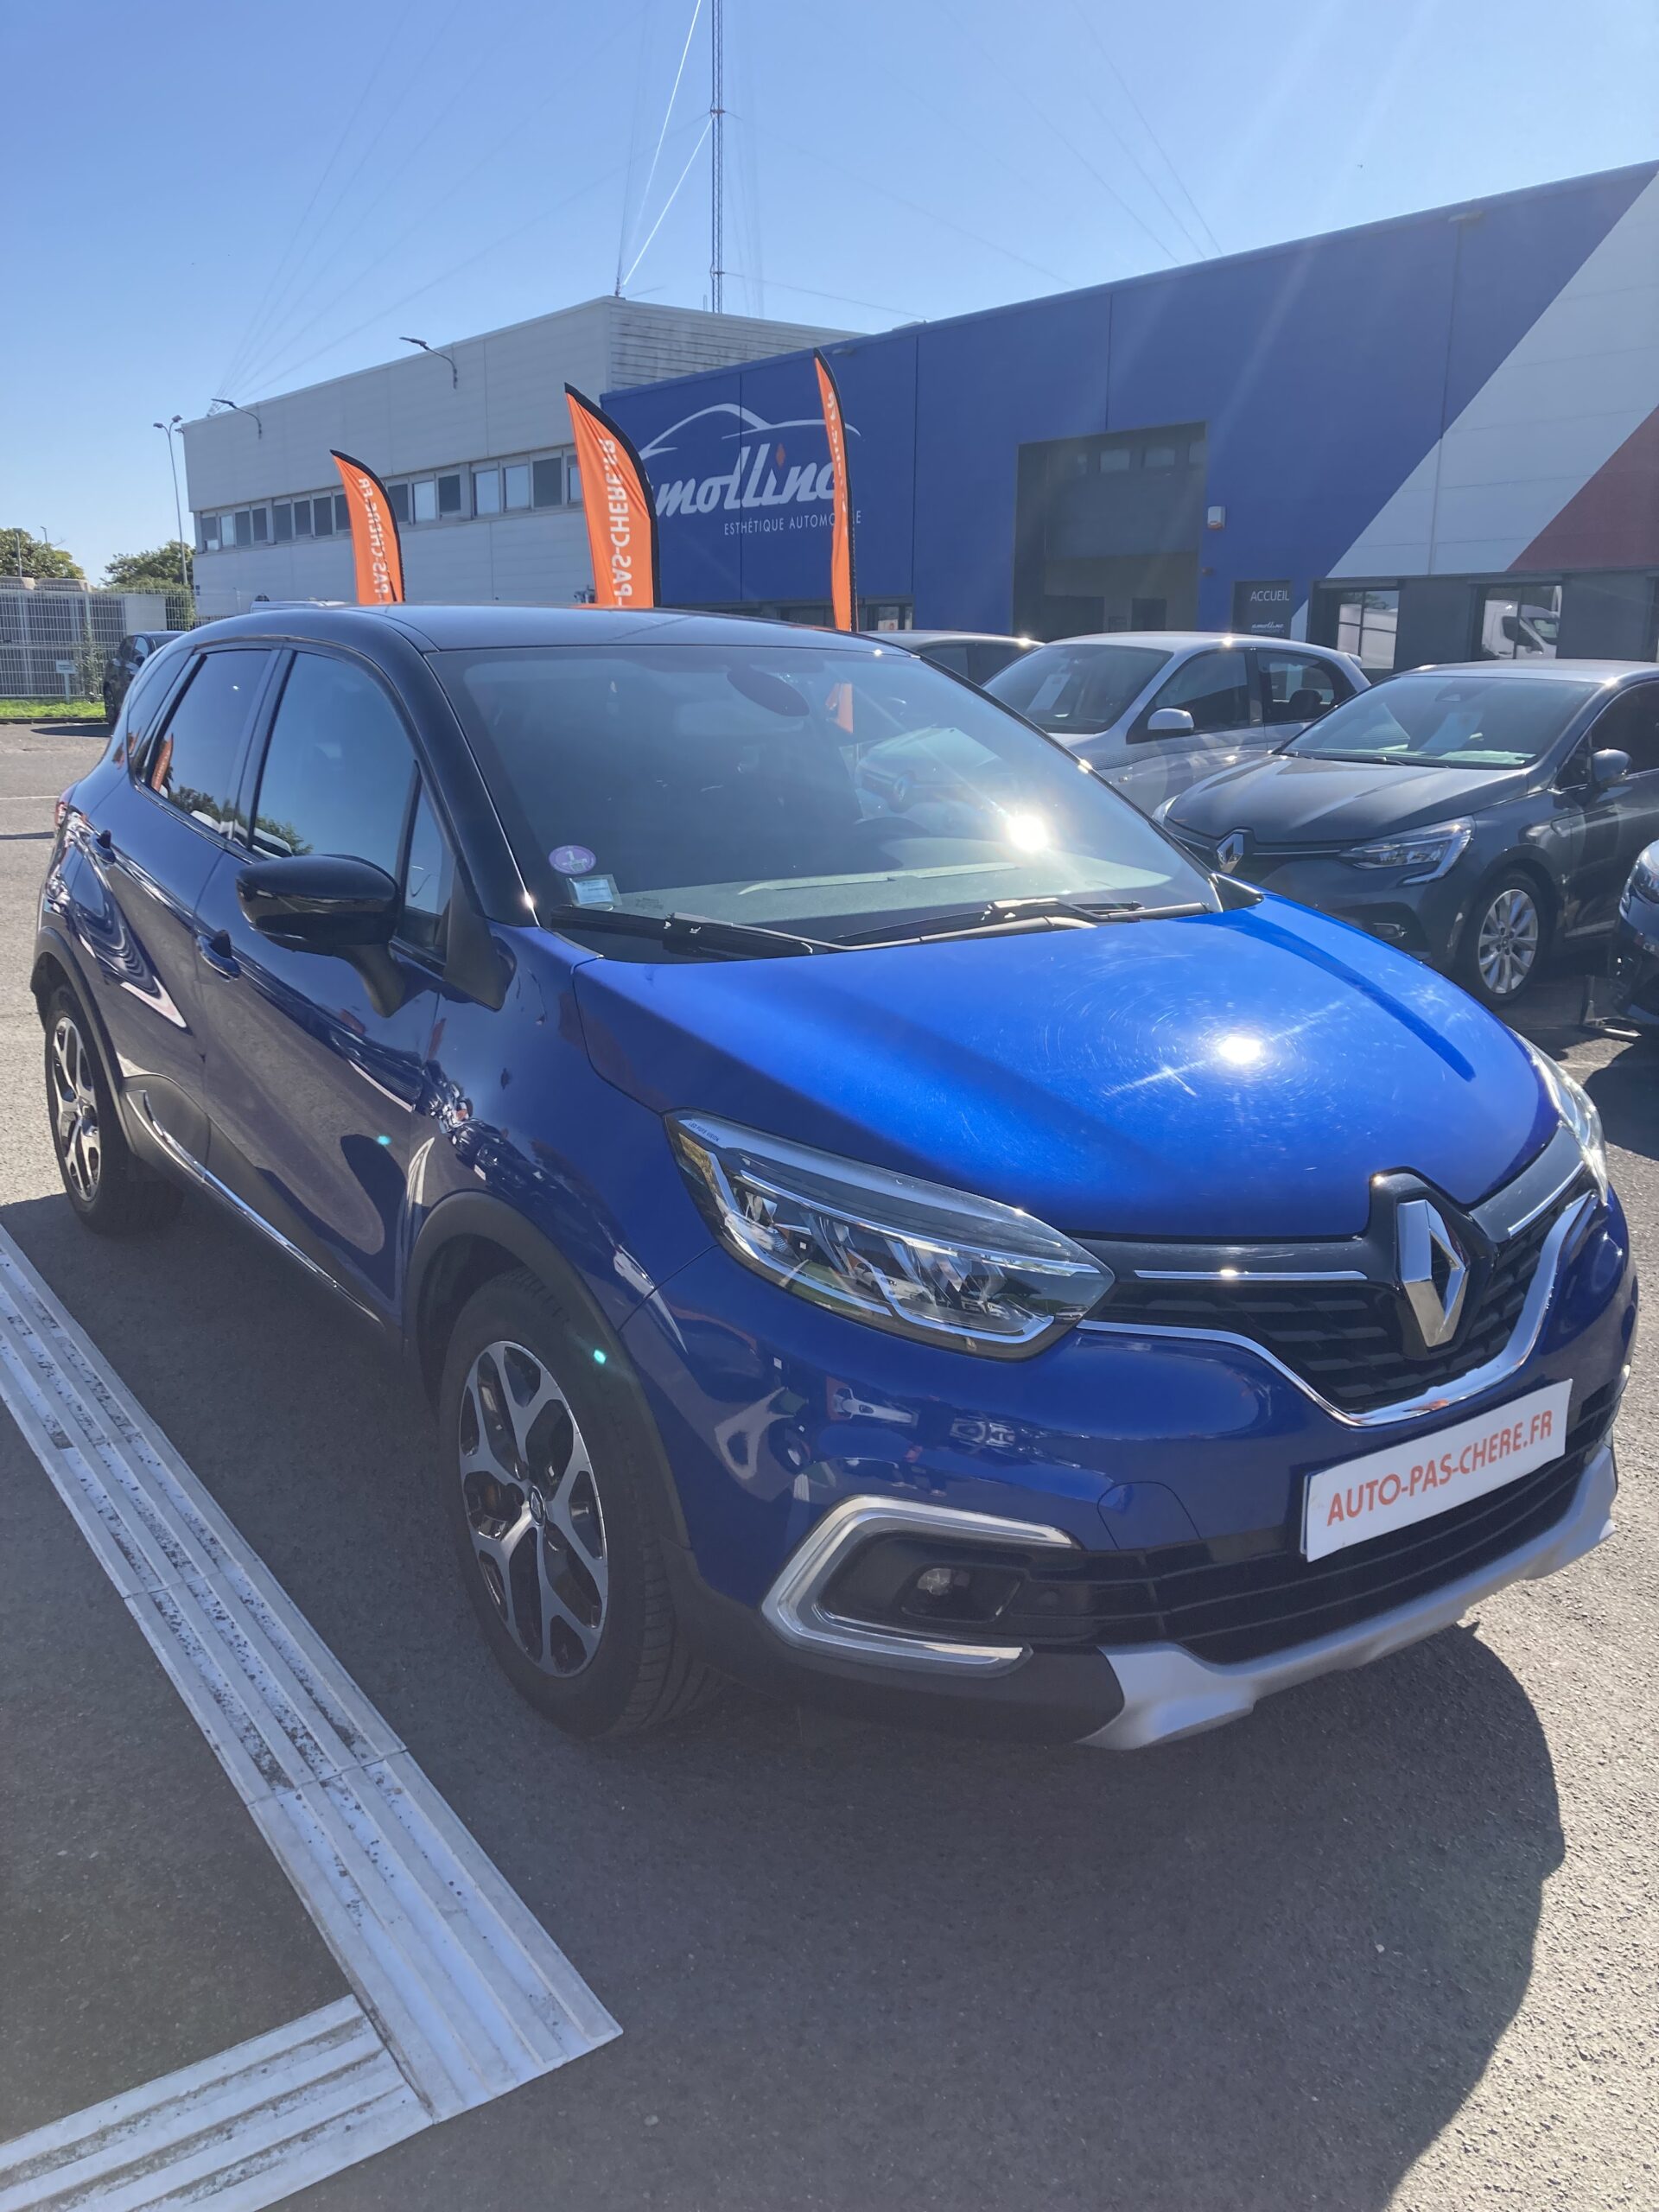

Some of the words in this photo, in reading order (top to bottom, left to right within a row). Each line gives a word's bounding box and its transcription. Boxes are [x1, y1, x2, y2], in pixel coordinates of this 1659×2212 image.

[724, 518, 785, 536] ESTHÉTIQUE
[789, 510, 861, 530] AUTOMOE
[1250, 589, 1290, 601] ACCUEIL
[1327, 1409, 1553, 1527] AUTO-PAS-CHERE.FR
